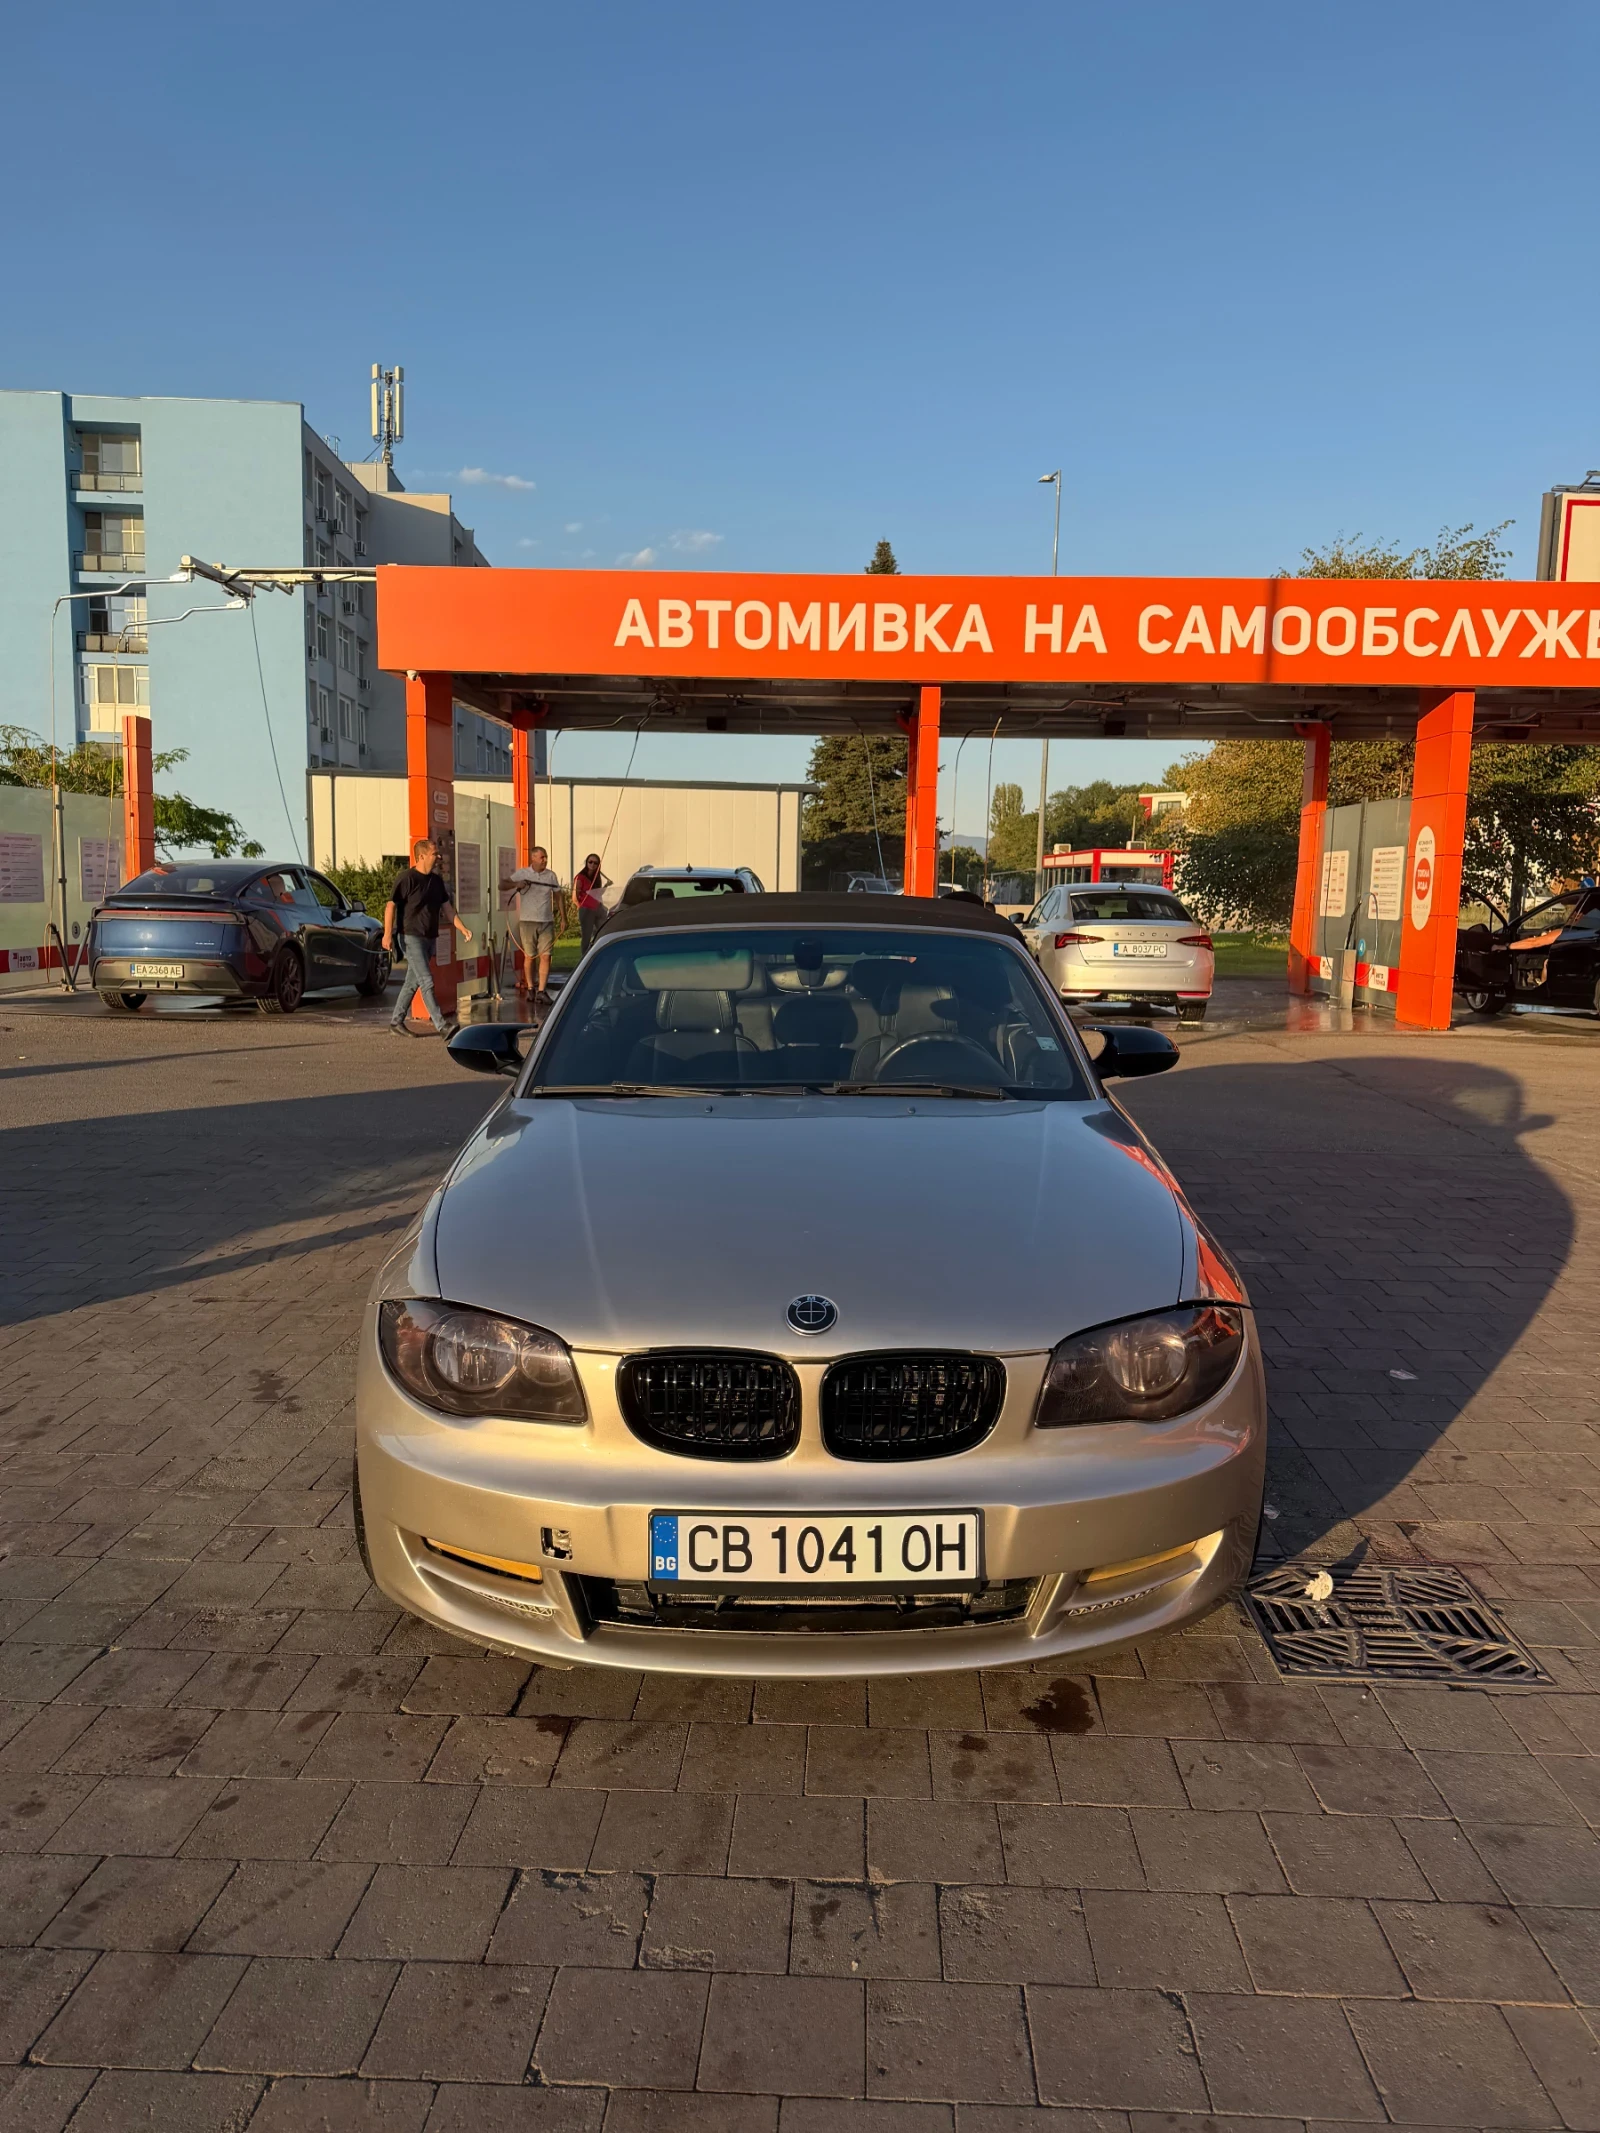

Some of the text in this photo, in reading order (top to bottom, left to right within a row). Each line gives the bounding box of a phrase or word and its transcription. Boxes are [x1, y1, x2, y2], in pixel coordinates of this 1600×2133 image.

[613, 598, 994, 653] АВТОМИВКА
[1024, 604, 1108, 654] НА
[1132, 945, 1152, 953] 8037
[1153, 945, 1165, 953] PC
[136, 965, 182, 976] EA 2368 AE
[655, 1523, 967, 1574] BG CB 1041 OH
